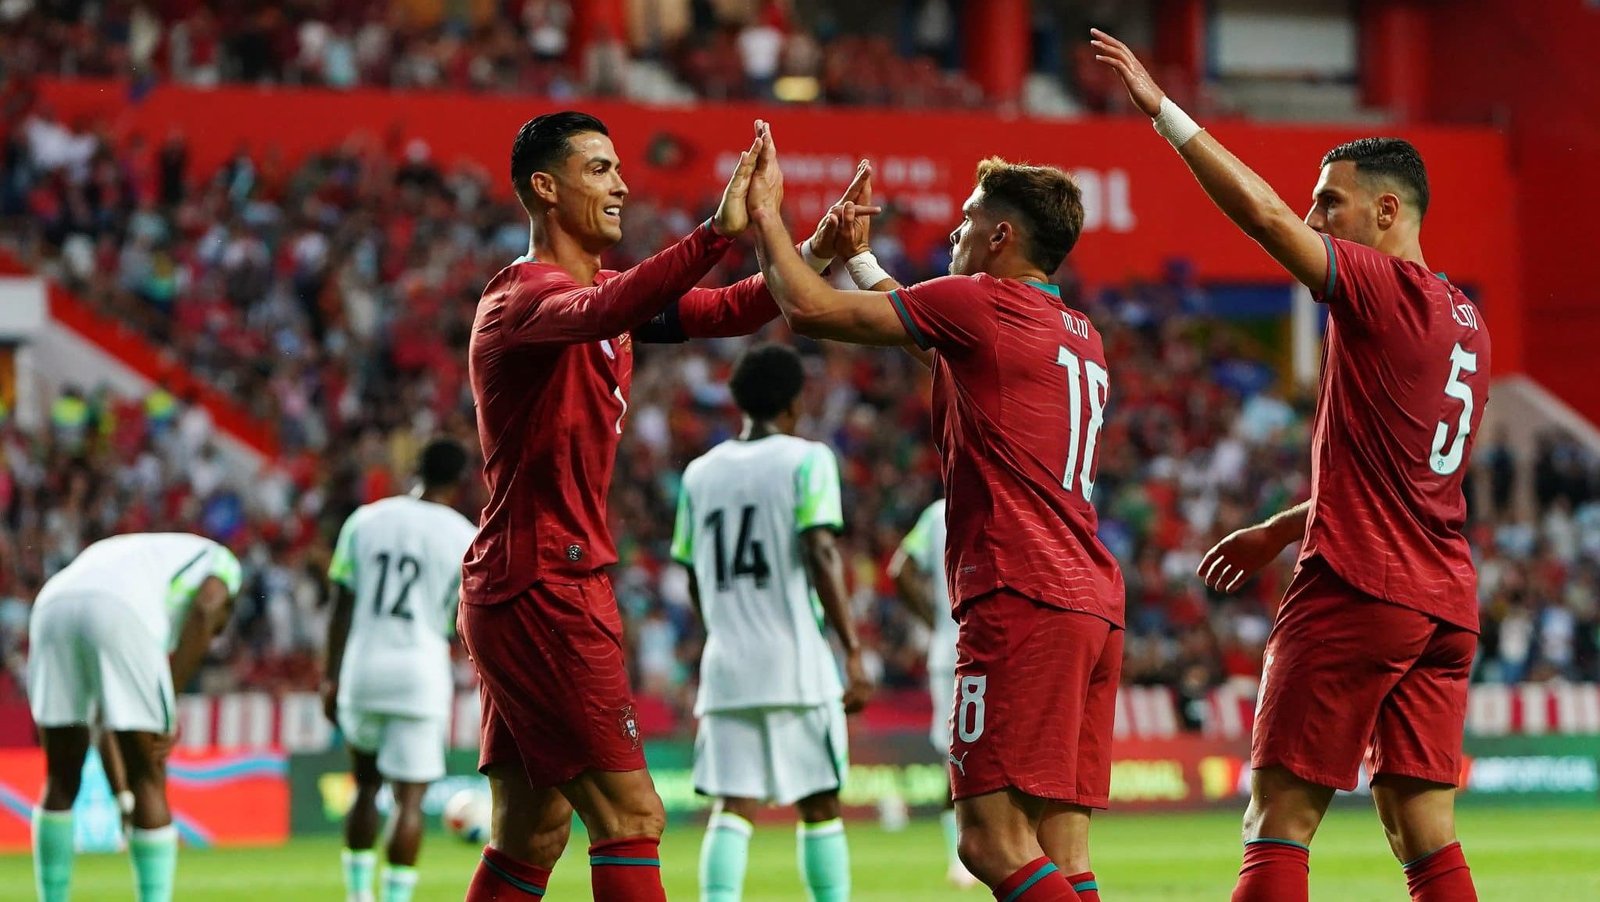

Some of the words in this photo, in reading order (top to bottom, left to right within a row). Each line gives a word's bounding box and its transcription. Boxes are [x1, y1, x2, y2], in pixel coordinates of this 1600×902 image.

[1056, 345, 1109, 502] 18
[1429, 342, 1477, 476] 5
[373, 551, 421, 622] 12
[704, 504, 771, 593] 14
